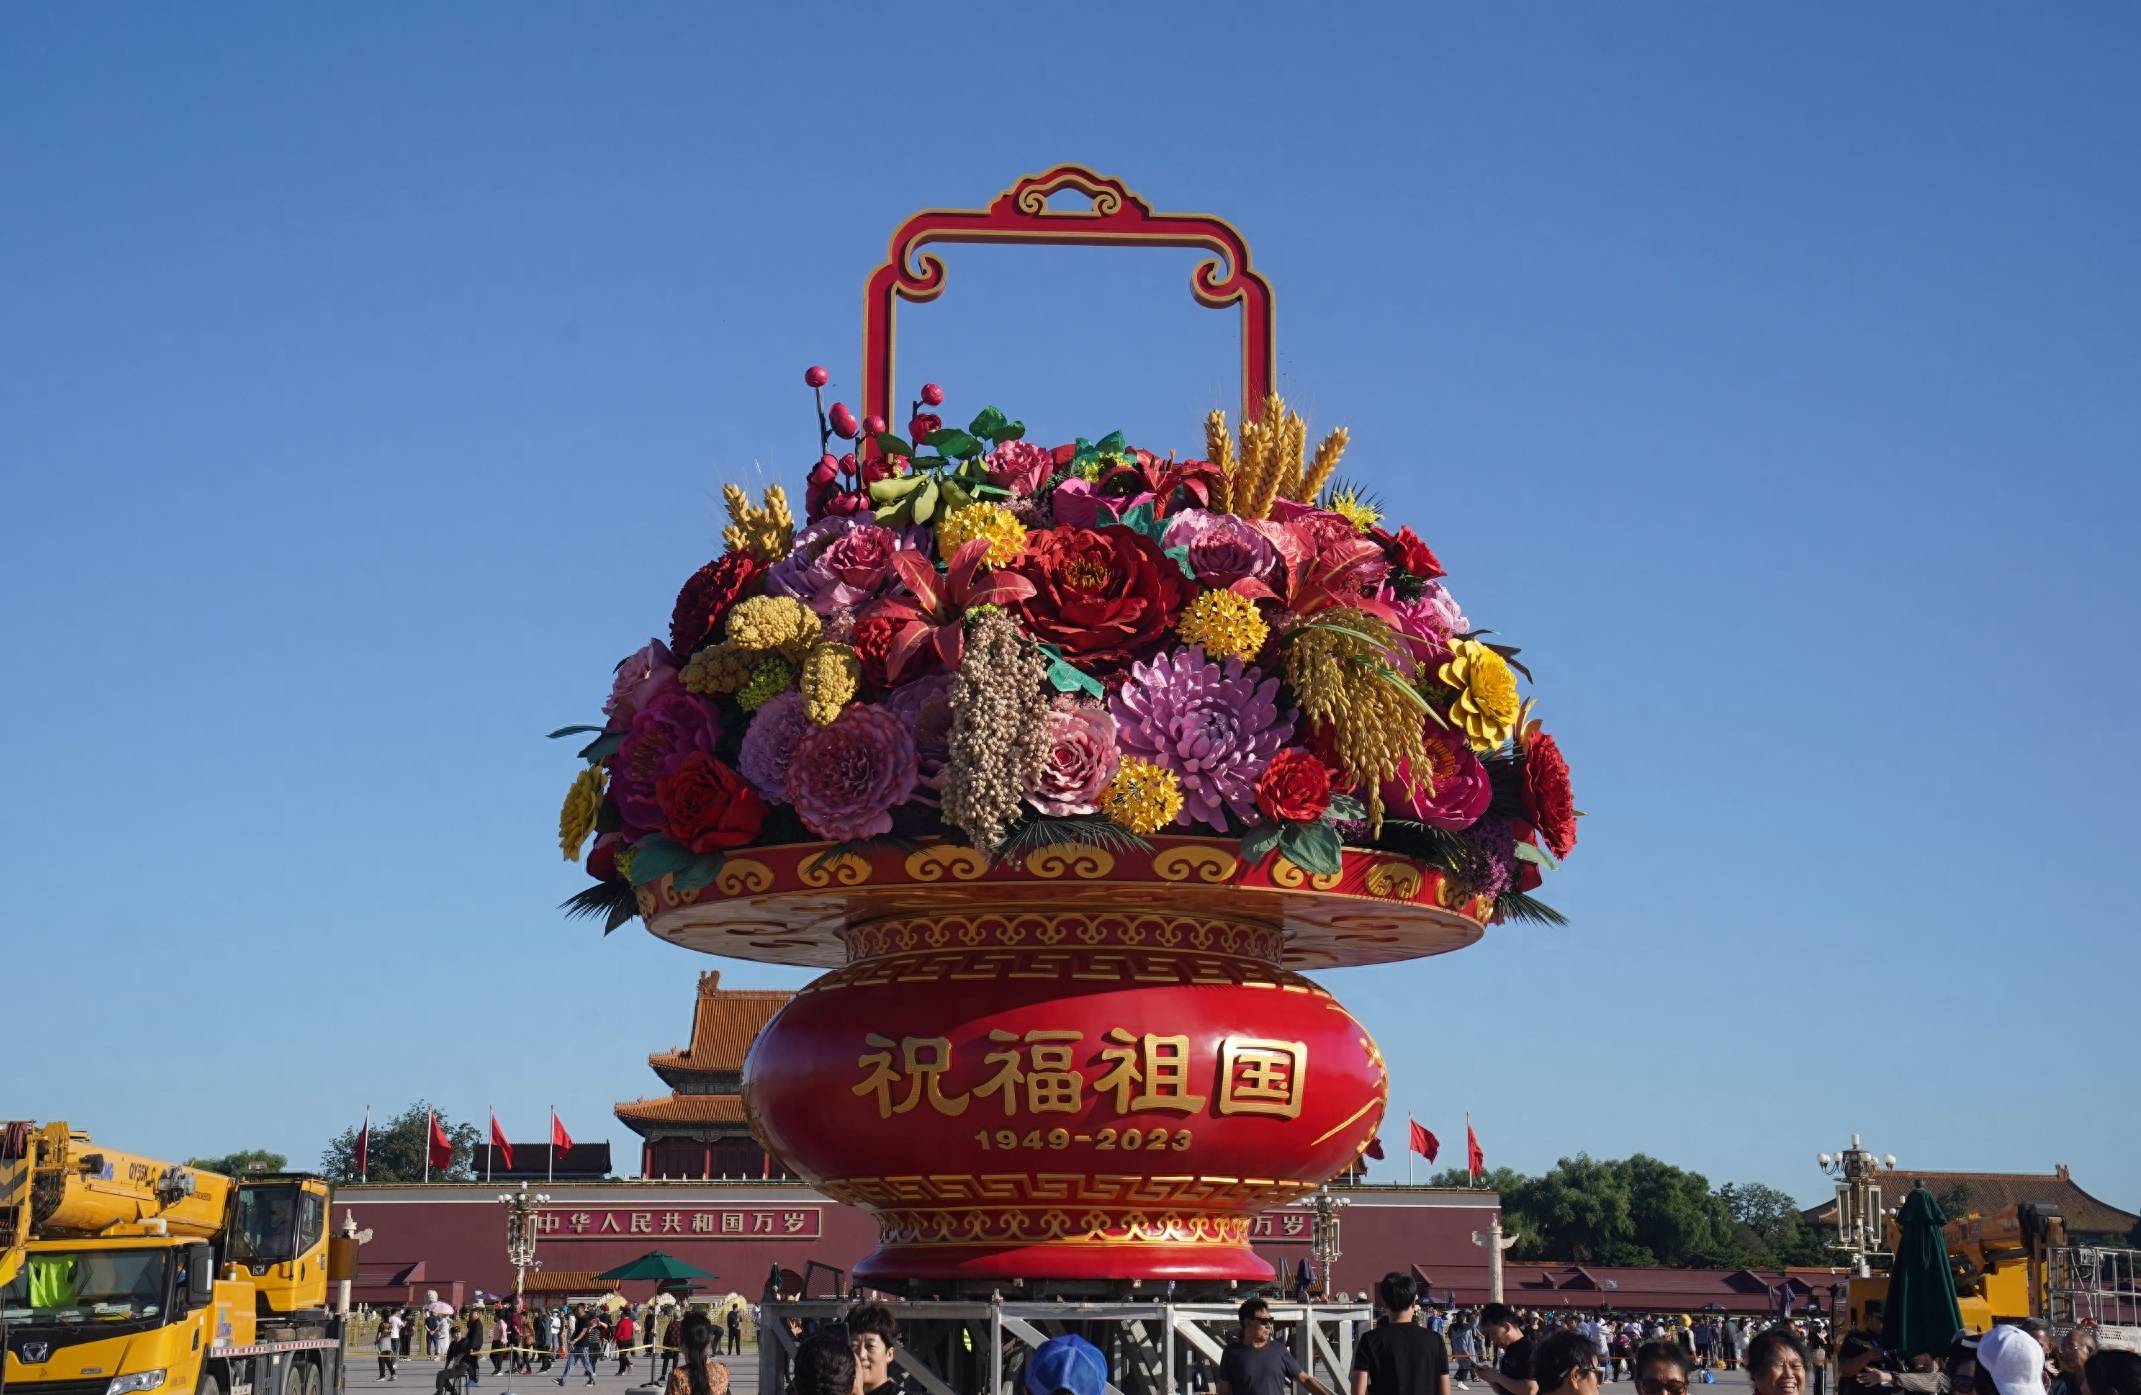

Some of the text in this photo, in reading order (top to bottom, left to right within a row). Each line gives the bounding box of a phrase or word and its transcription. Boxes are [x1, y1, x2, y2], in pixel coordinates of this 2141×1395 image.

[851, 1028, 1308, 1120] 祝福祖国
[974, 1128, 1193, 1152] 1949-2023
[537, 1213, 806, 1233] 中华人民共和国万岁
[1253, 1215, 1304, 1236] 万岁
